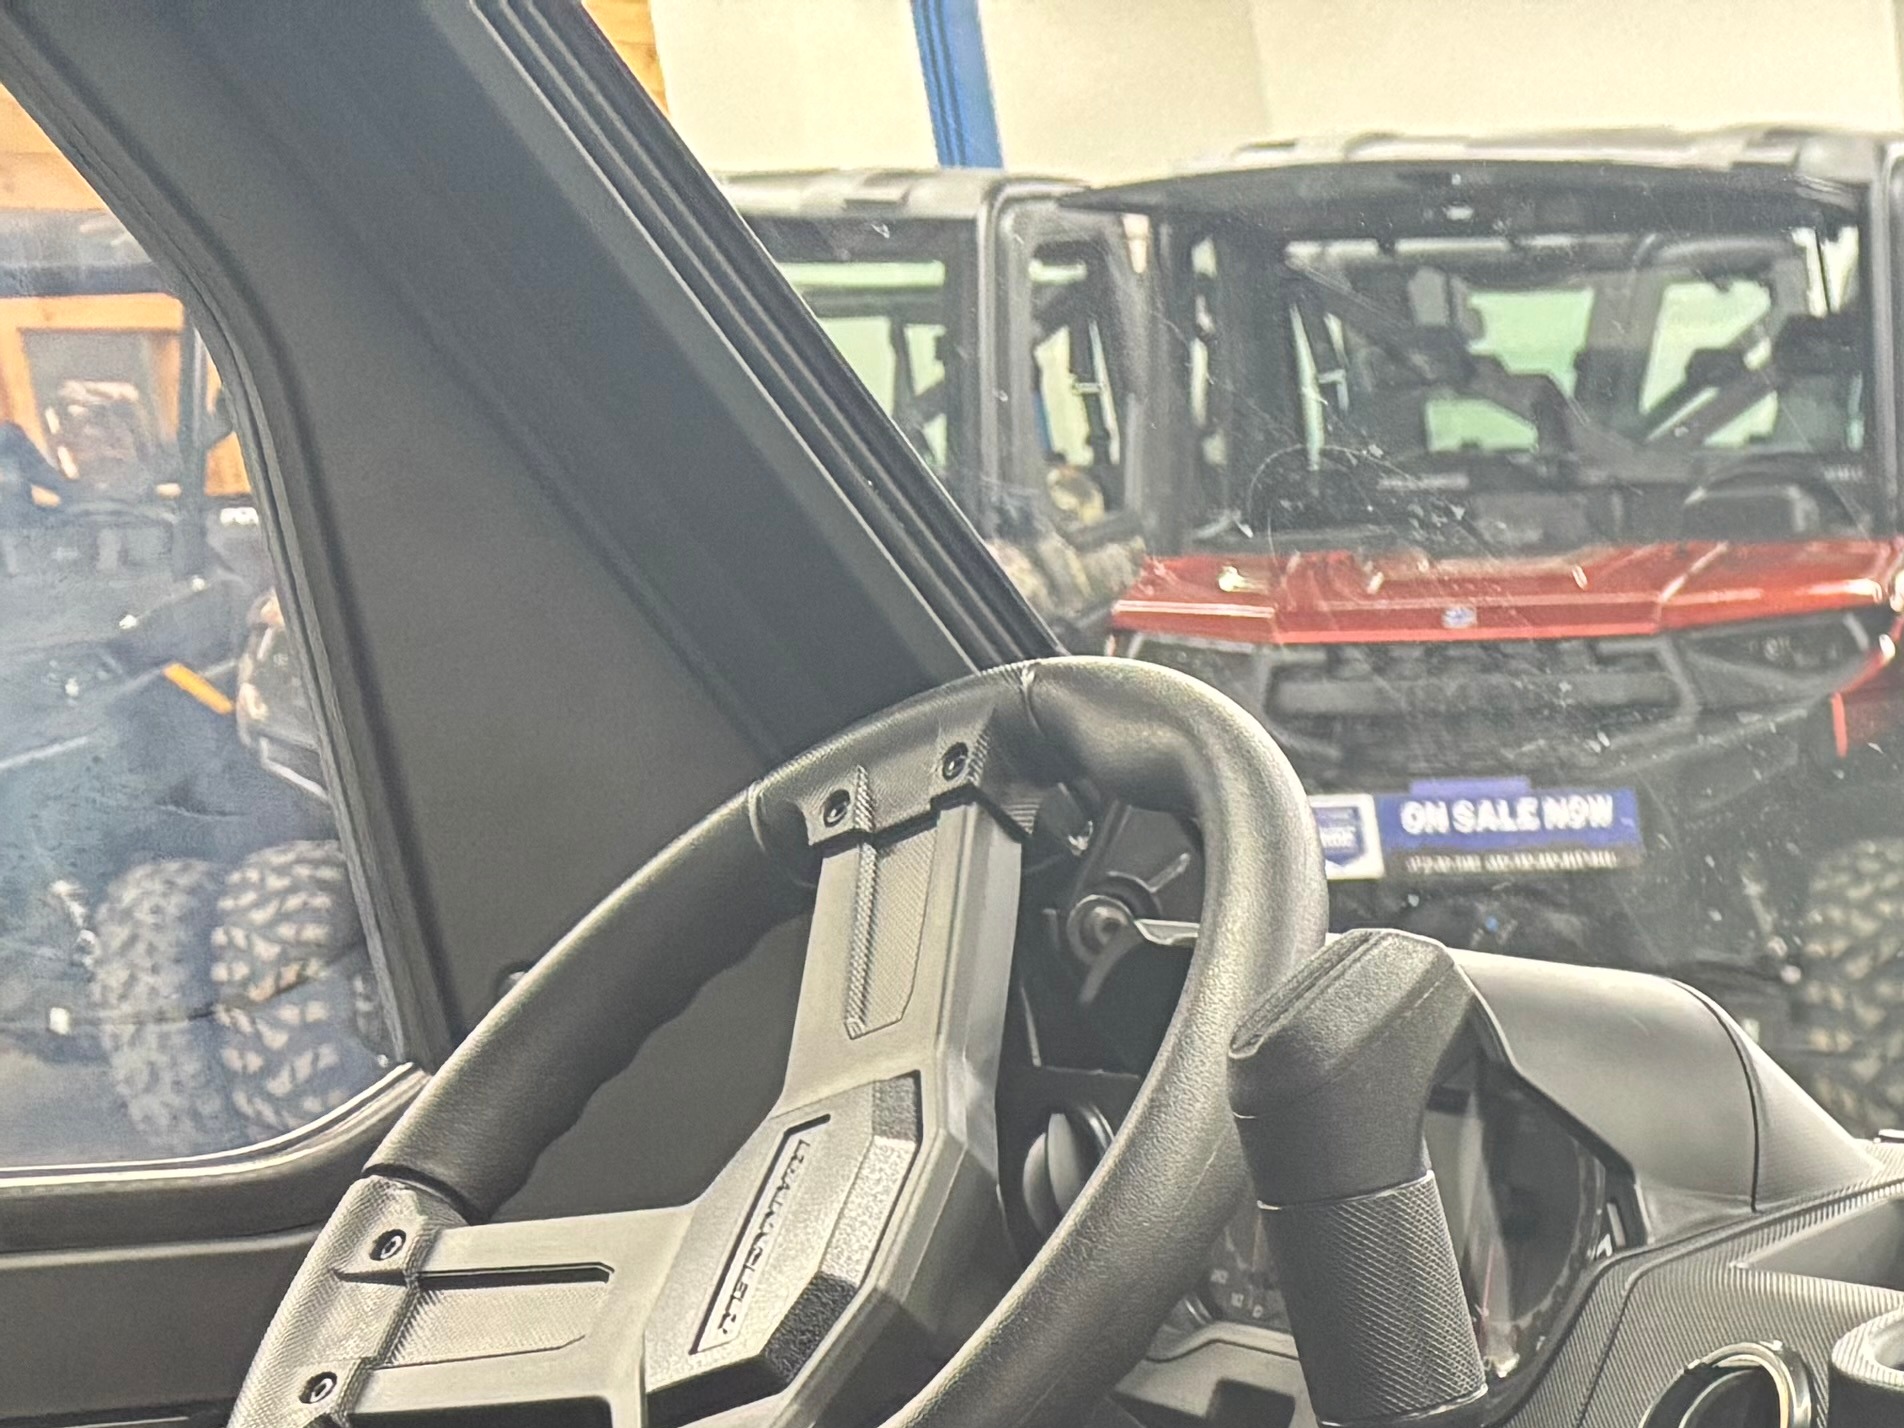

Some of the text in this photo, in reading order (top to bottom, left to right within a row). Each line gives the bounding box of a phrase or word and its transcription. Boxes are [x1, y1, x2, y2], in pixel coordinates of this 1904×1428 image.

[1400, 800, 1450, 835] ON
[1452, 797, 1541, 834] SALE
[1542, 793, 1614, 830] NOW
